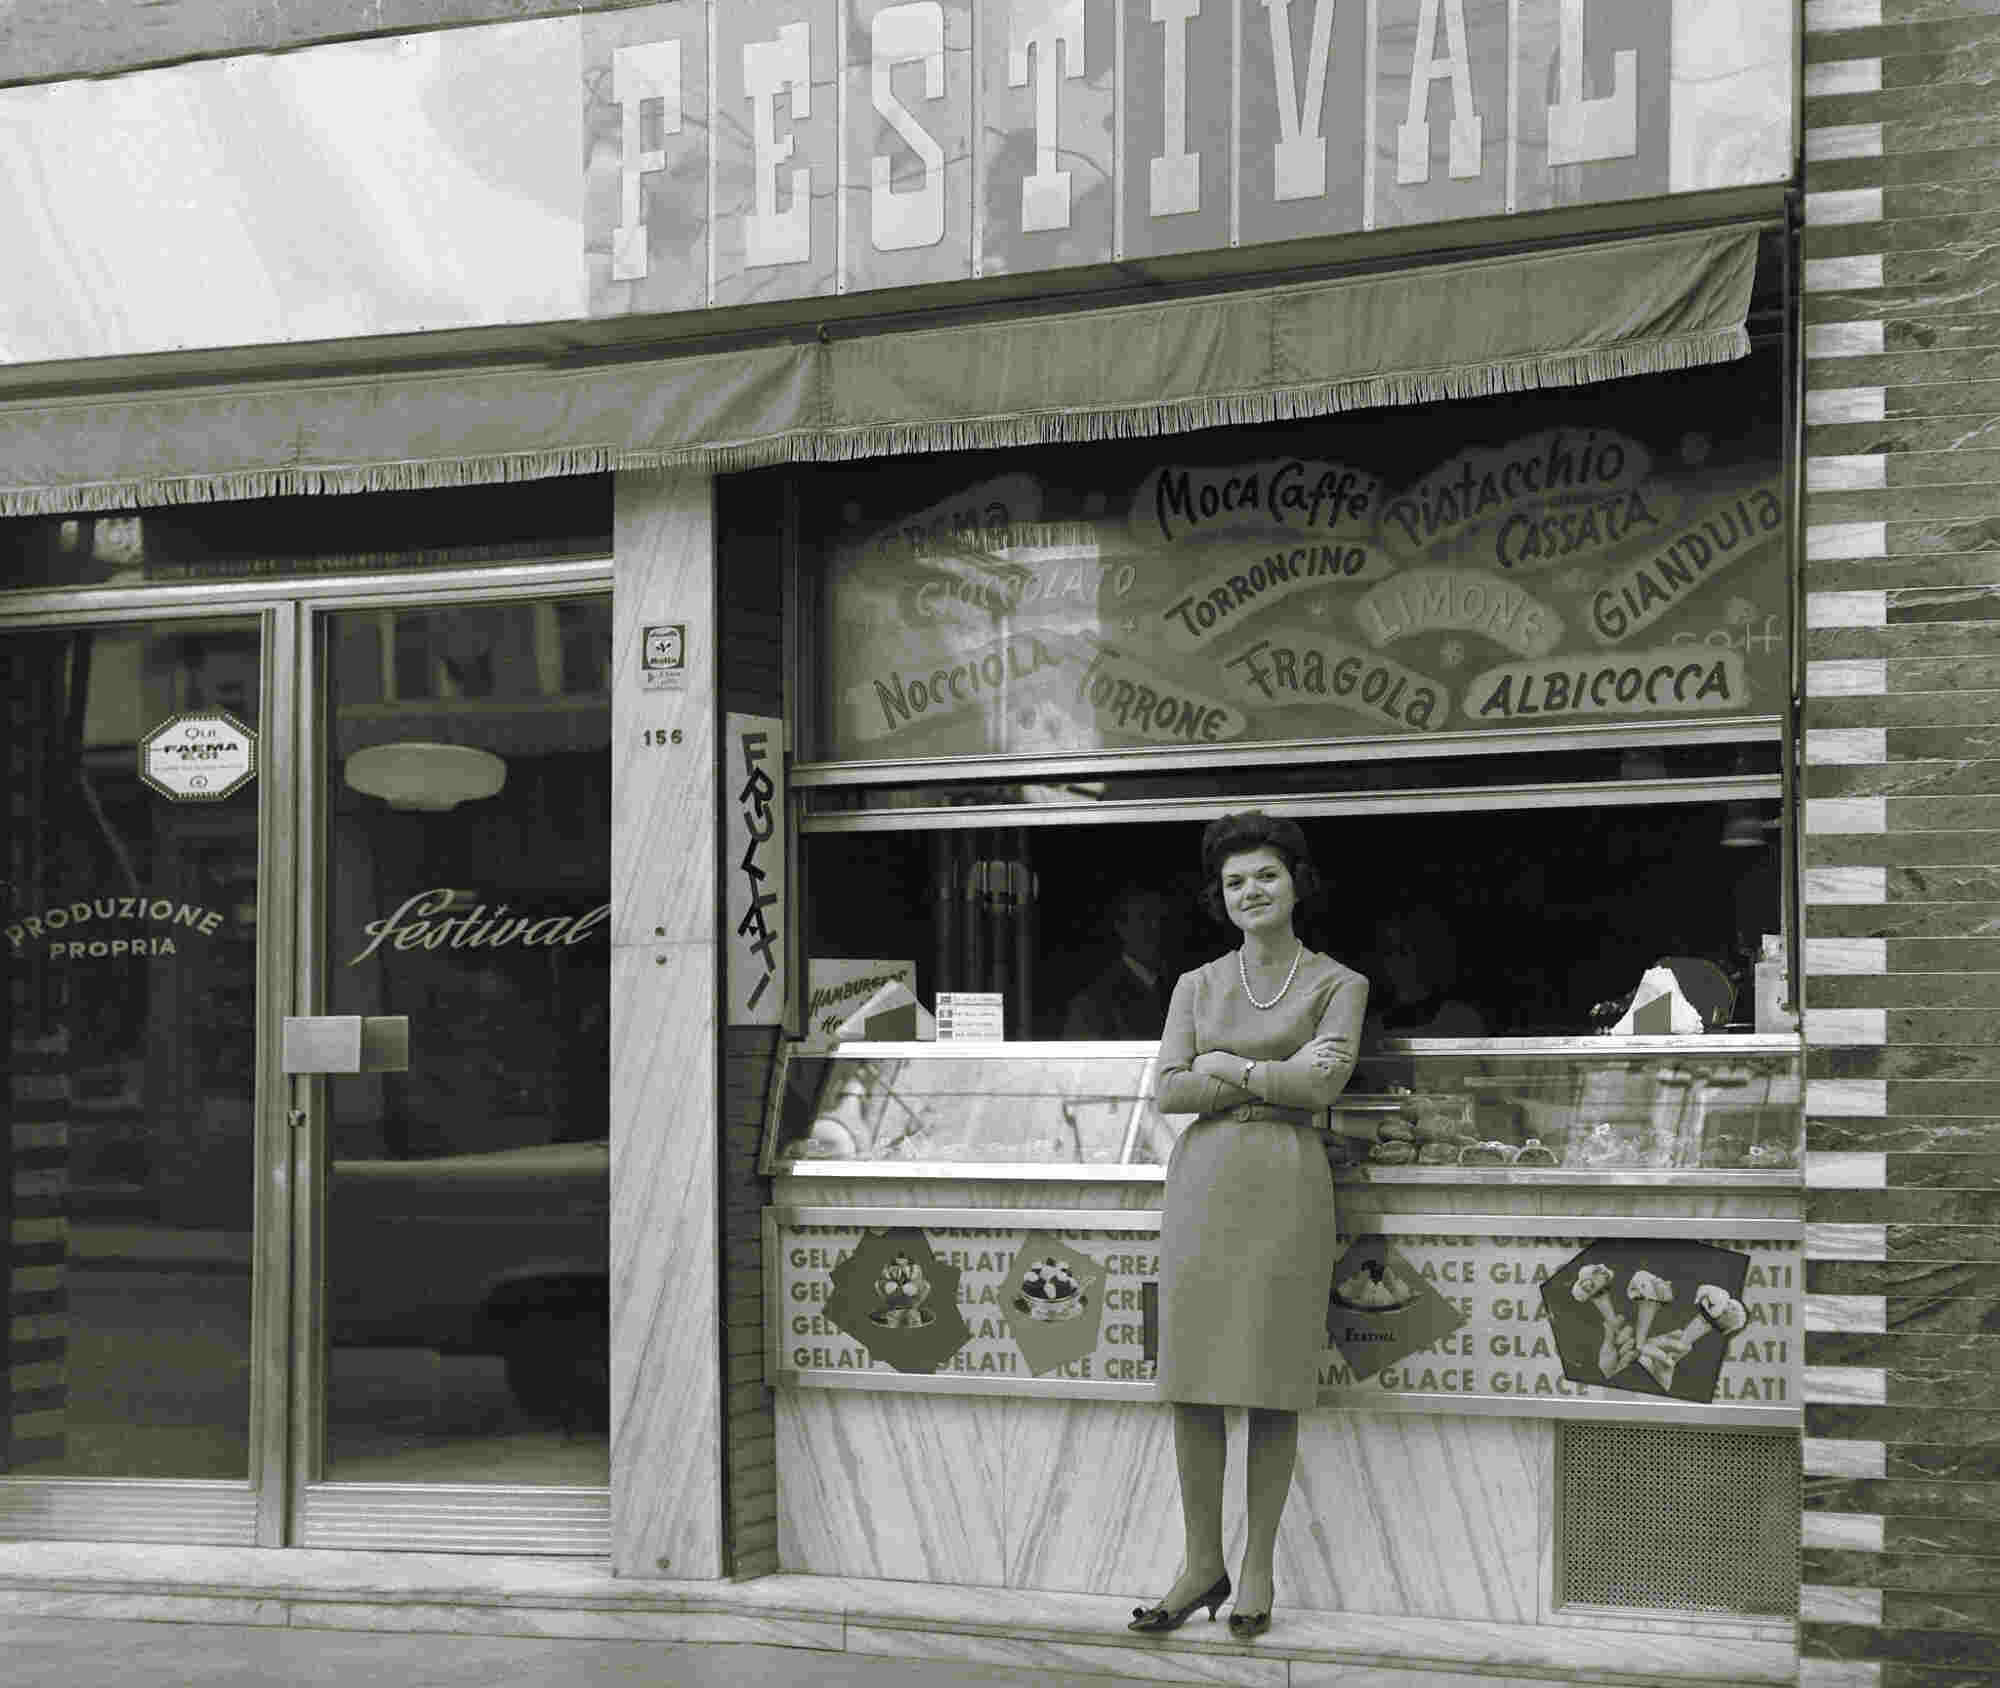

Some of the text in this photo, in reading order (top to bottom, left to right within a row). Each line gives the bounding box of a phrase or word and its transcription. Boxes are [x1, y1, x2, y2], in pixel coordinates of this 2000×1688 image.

[612, 0, 1637, 281] FESTIVAL
[1495, 488, 1659, 568] CASSATA
[1163, 544, 1367, 636] TORRONCINO
[1367, 576, 1546, 648] LIMONE
[873, 637, 1060, 730] NOCCIOLA
[1078, 648, 1230, 741] TORRONE
[1479, 661, 1732, 717] ALBICOCCA
[642, 730, 684, 746] 156
[739, 732, 778, 1011] FRULLATI
[5, 897, 225, 946] PRODUZIONE
[50, 936, 177, 960] PROPRIA
[1104, 1254, 1158, 1275] CREA
[1418, 1261, 1792, 1288] ACE GLA ATI
[1491, 1298, 1549, 1321] GLA
[1749, 1302, 1792, 1325] ATI
[1056, 1358, 1091, 1378] ICE
[1489, 1335, 1551, 1357] GLA
[1378, 1368, 1474, 1391] GLACE
[1718, 1377, 1787, 1400] LATI
